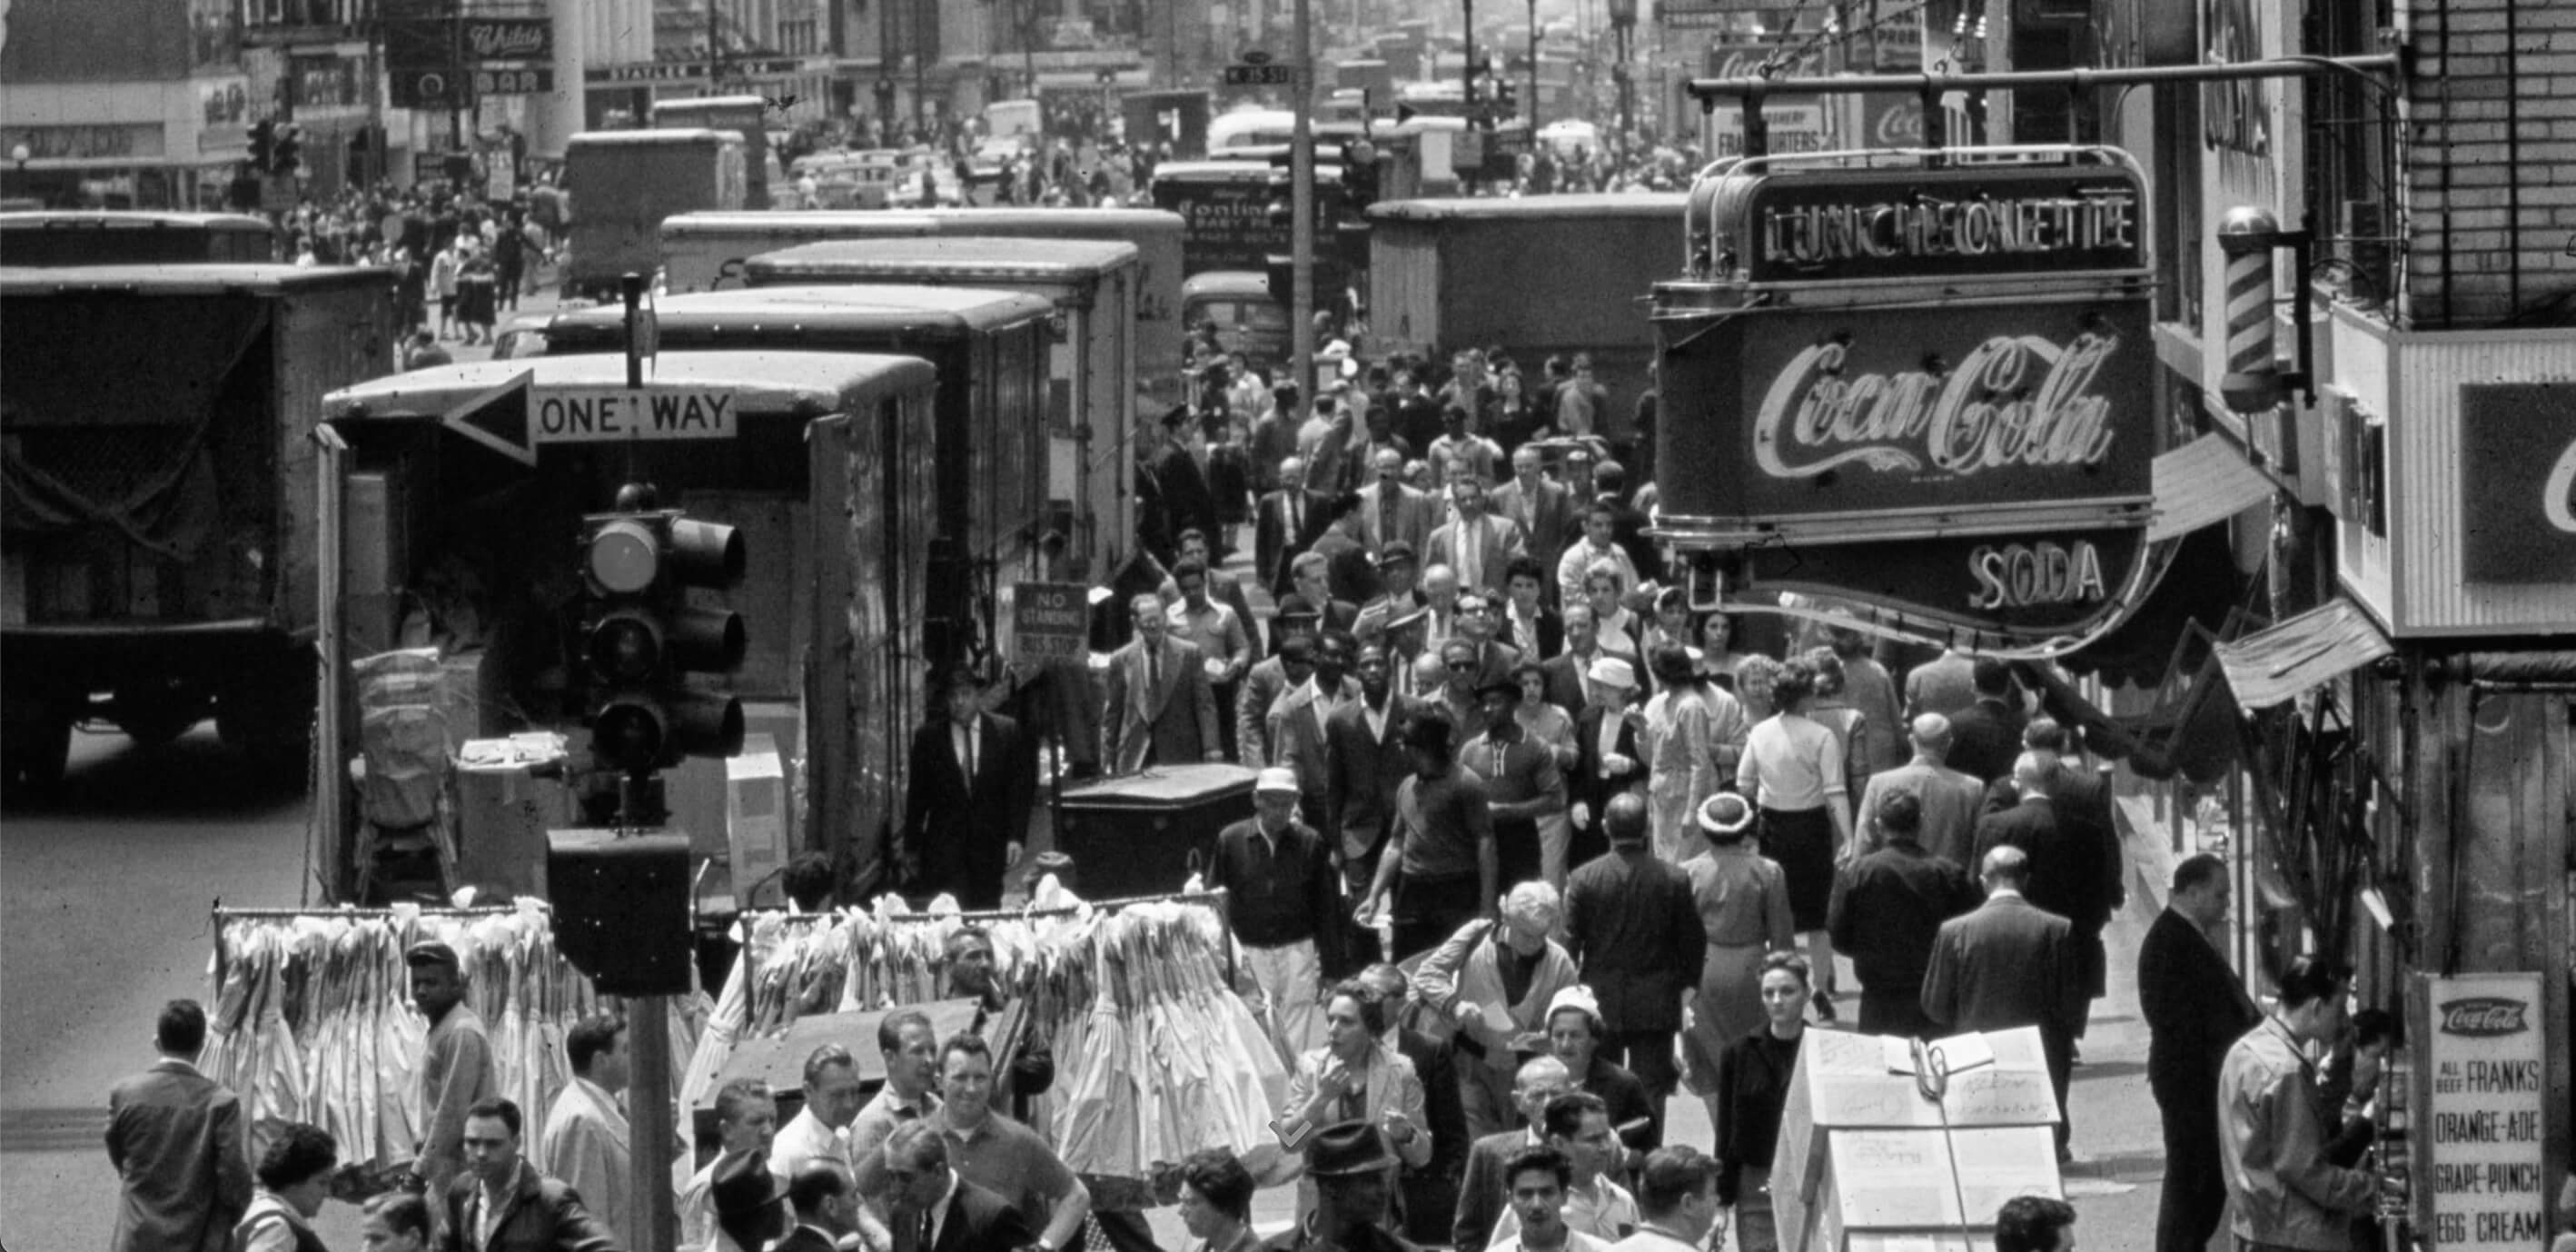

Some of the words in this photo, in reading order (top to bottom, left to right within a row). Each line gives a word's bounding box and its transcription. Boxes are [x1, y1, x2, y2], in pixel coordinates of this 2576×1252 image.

[476, 72, 539, 92] BAR
[1718, 131, 1819, 156] FRAURTERS
[1765, 191, 2134, 262] LUNCHEONETTE
[540, 397, 622, 434] ONE
[651, 393, 729, 431] WAY
[1967, 541, 2105, 610] SODA
[1037, 593, 1066, 608] NO
[2440, 1061, 2459, 1076] ALL
[2466, 1059, 2540, 1093] FRANKS
[2435, 1078, 2463, 1093] BEEF
[2435, 1109, 2539, 1143] ORANGE-ADE
[2434, 1163, 2541, 1194] GRAPE-PUNCH
[2436, 1212, 2466, 1244] EGG
[2476, 1211, 2541, 1244] CREAM
